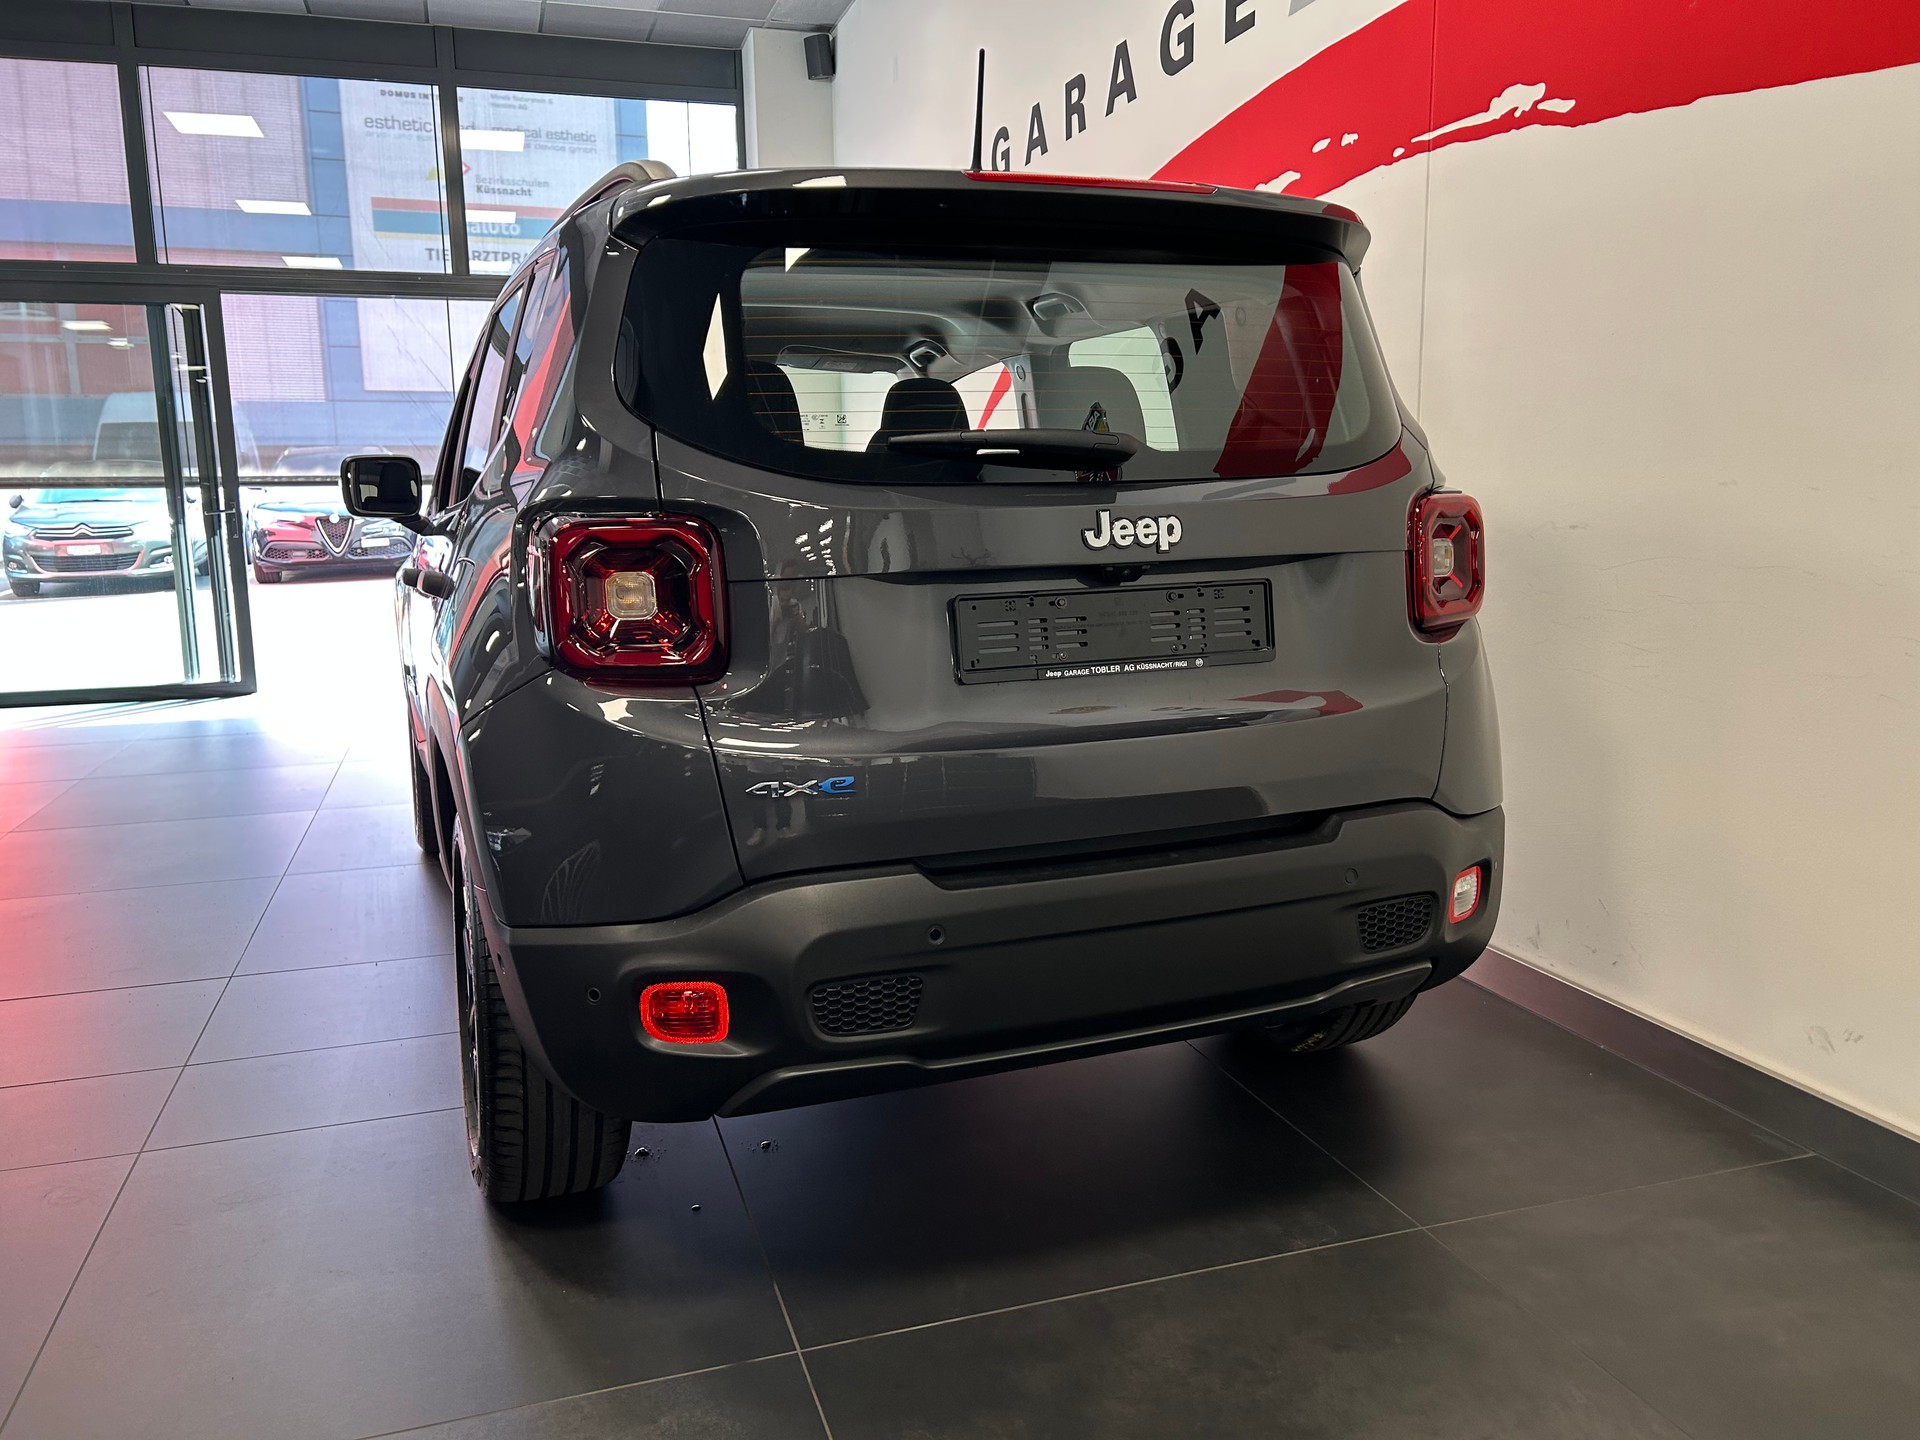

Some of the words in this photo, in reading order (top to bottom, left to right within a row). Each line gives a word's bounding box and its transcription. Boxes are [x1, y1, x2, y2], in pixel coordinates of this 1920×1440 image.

[991, 0, 1256, 172] GARAGE
[380, 89, 416, 99] DOMUS
[364, 115, 433, 133] esthetic
[546, 129, 597, 143] esthetic
[475, 175, 550, 188] Bezirksschulen
[476, 185, 533, 197] Küssnacht
[1082, 509, 1182, 553] Jeep
[1045, 670, 1062, 678] Jeep
[1063, 668, 1090, 677] GARAGE
[1090, 665, 1121, 675] TOBLER
[1123, 664, 1135, 672] AG
